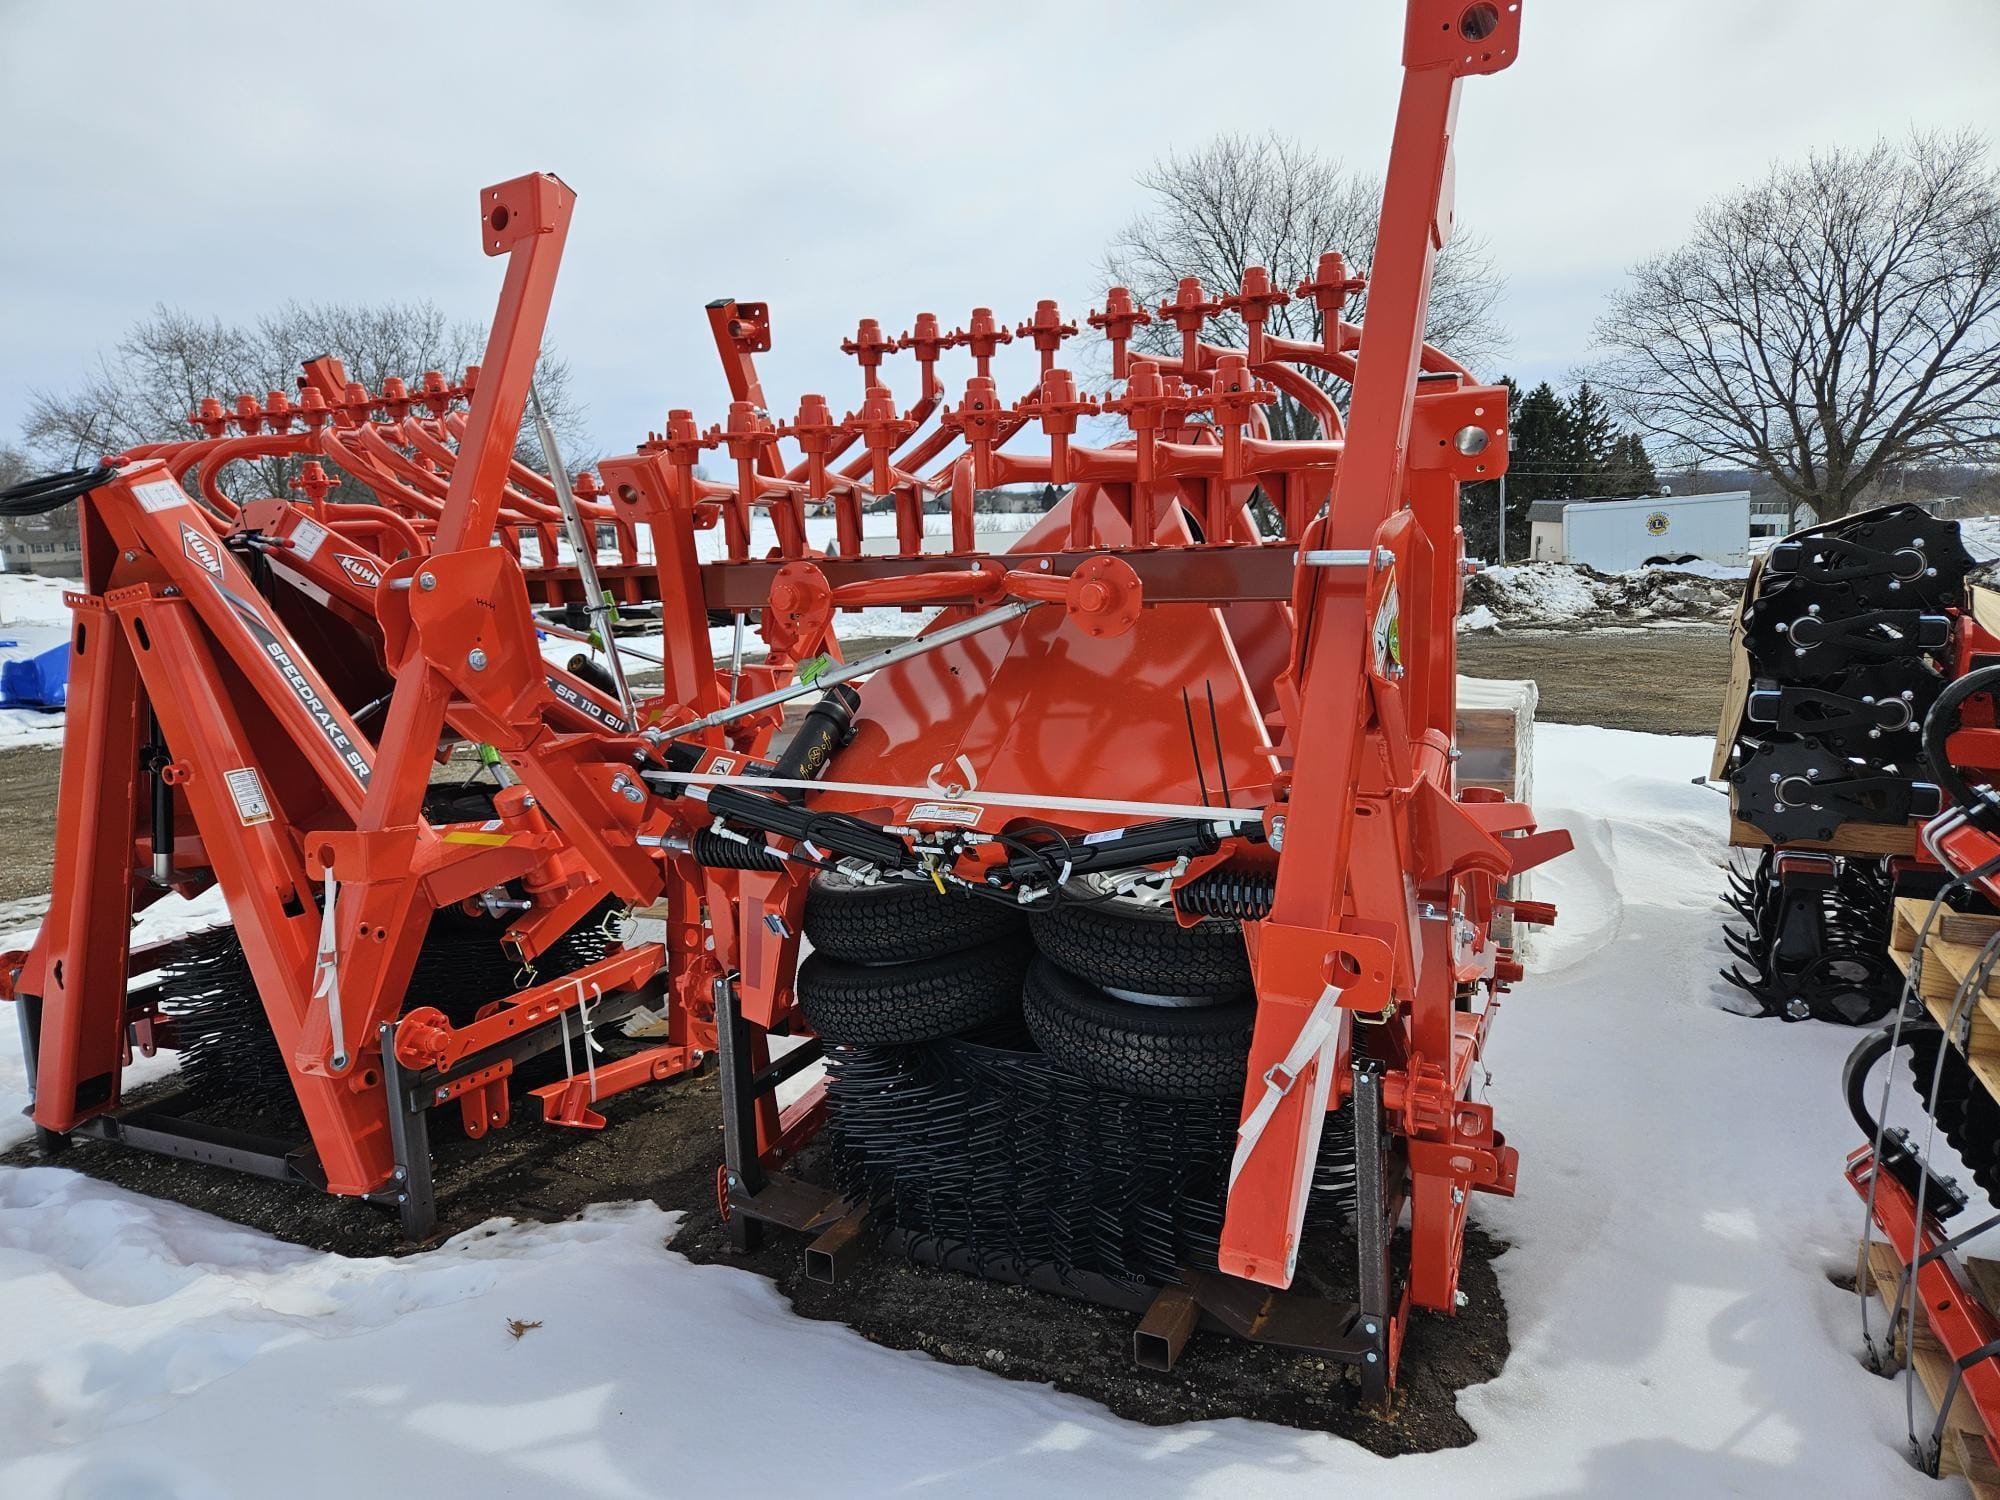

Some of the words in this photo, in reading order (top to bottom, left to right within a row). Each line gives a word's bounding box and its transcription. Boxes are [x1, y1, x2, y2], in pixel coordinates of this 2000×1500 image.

[183, 531, 220, 573] KUHN
[341, 557, 379, 586] KUHN
[266, 642, 350, 749] SPEEDRAKE
[346, 751, 371, 778] SR
[555, 684, 578, 703] SR
[581, 698, 602, 718] 110
